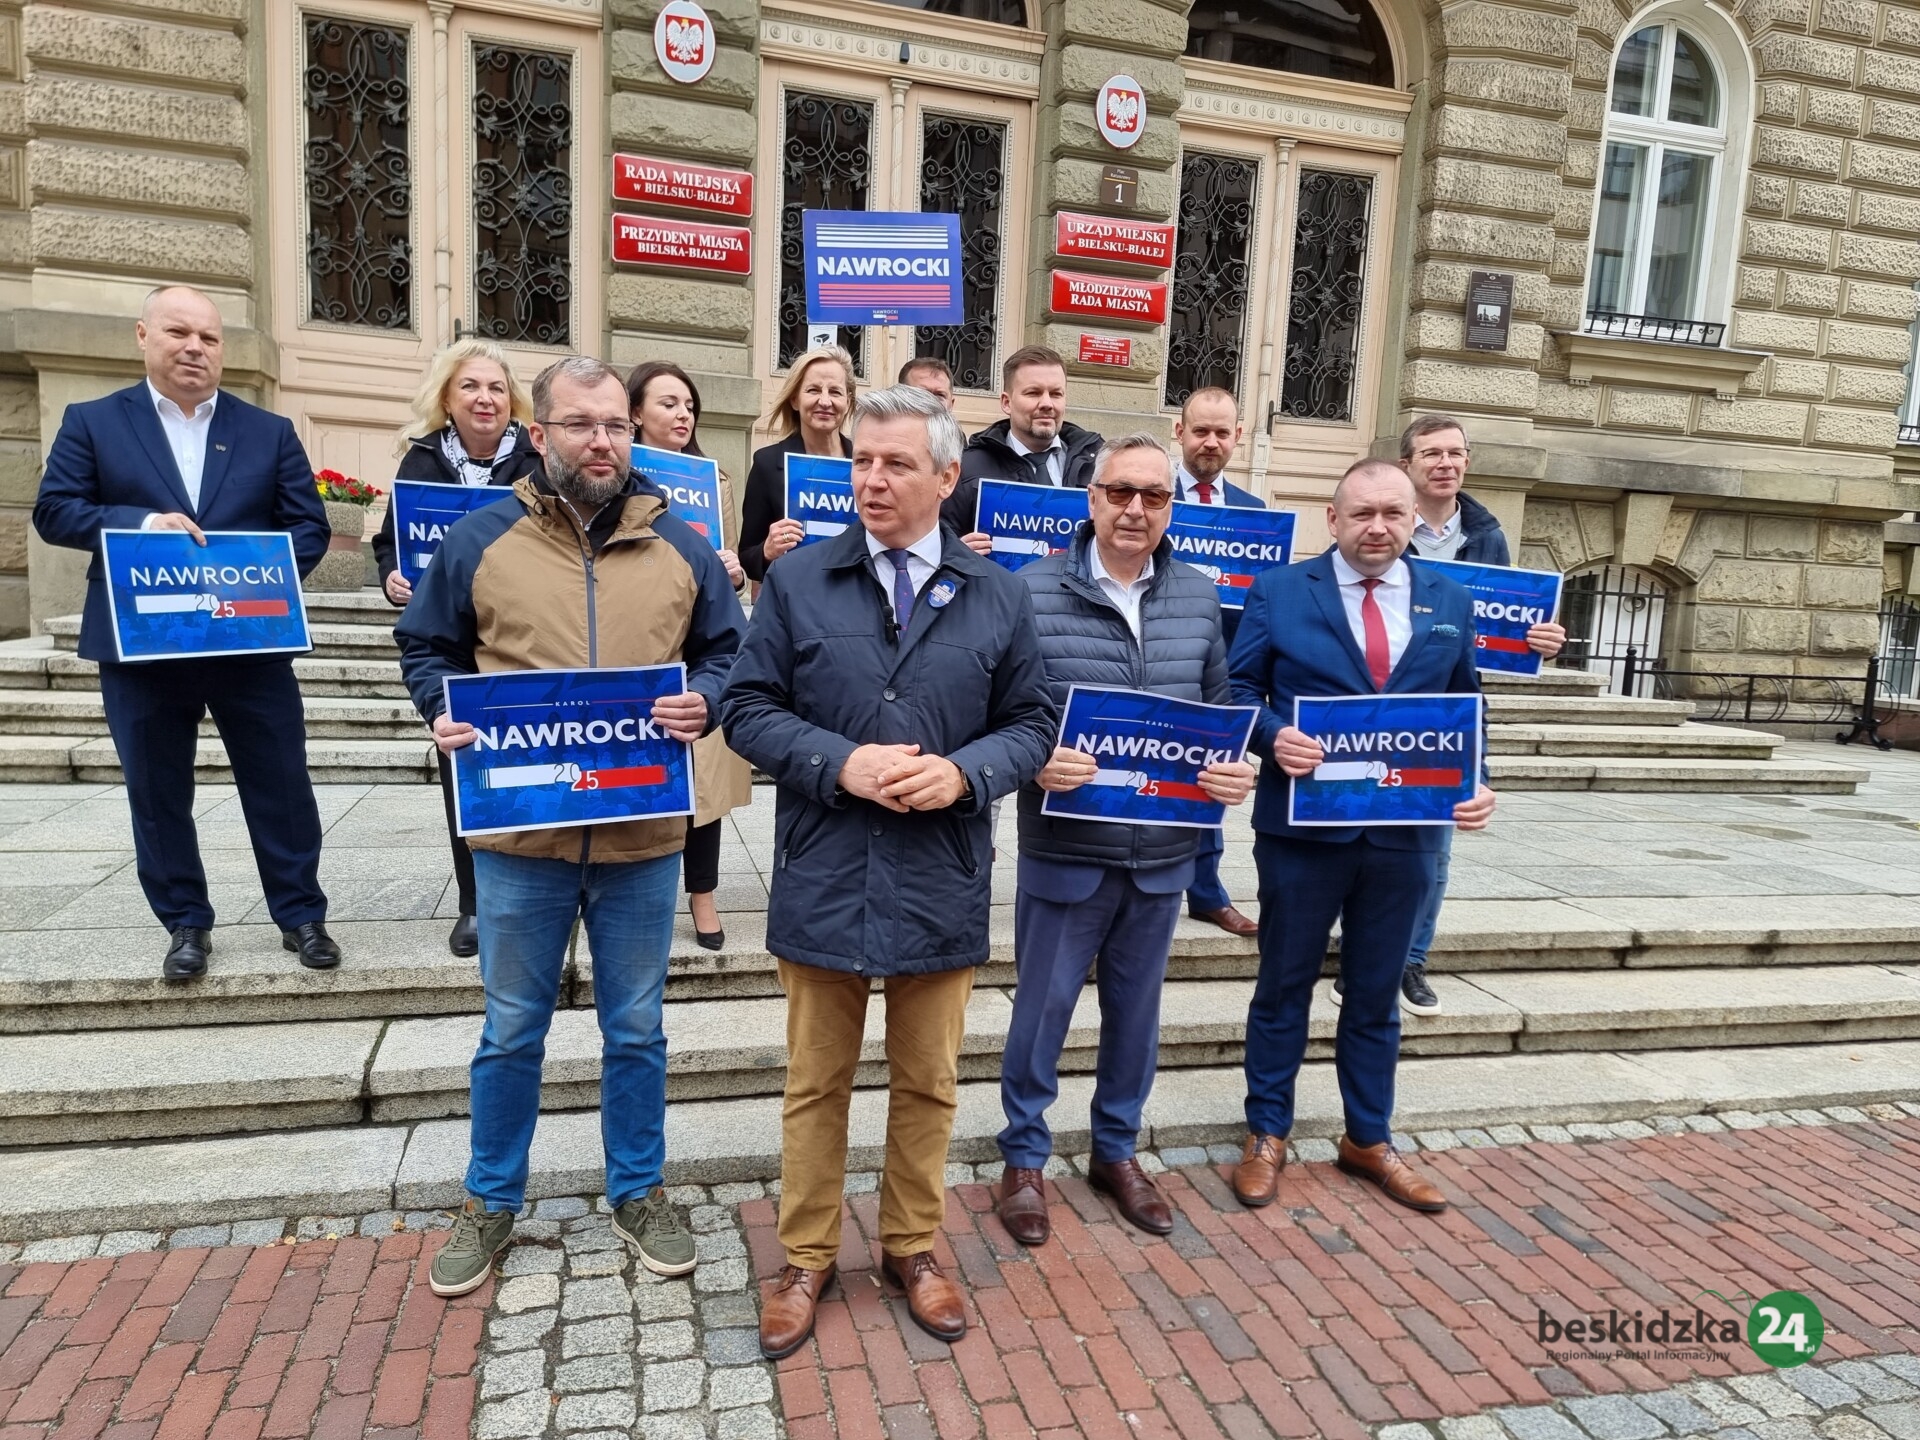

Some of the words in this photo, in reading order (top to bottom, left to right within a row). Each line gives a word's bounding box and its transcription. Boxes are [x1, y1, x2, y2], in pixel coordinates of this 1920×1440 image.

[625, 164, 667, 183] RADA
[673, 171, 741, 194] MIEJSKA
[633, 183, 641, 191] w
[644, 182, 735, 205] BIELSKU-BIAŁEJ
[1115, 184, 1123, 203] 1
[621, 225, 696, 245] PREZYDENT
[699, 234, 743, 251] MIASTA
[1067, 222, 1112, 238] URZĄD
[1116, 228, 1167, 244] MIEJSKI
[638, 242, 726, 261] BIELSKA-BIAŁEJ
[1078, 238, 1164, 258] BIELSKU-BIAŁEJ
[817, 256, 950, 277] NAWROCKI
[1069, 281, 1152, 300] MŁODZIEŻOWA
[1071, 294, 1102, 307] RADA
[1106, 298, 1149, 313] MIASTA
[130, 566, 284, 587] NAWROCKI
[1145, 720, 1175, 729] KAROL
[1315, 731, 1463, 753] NAWROCKI
